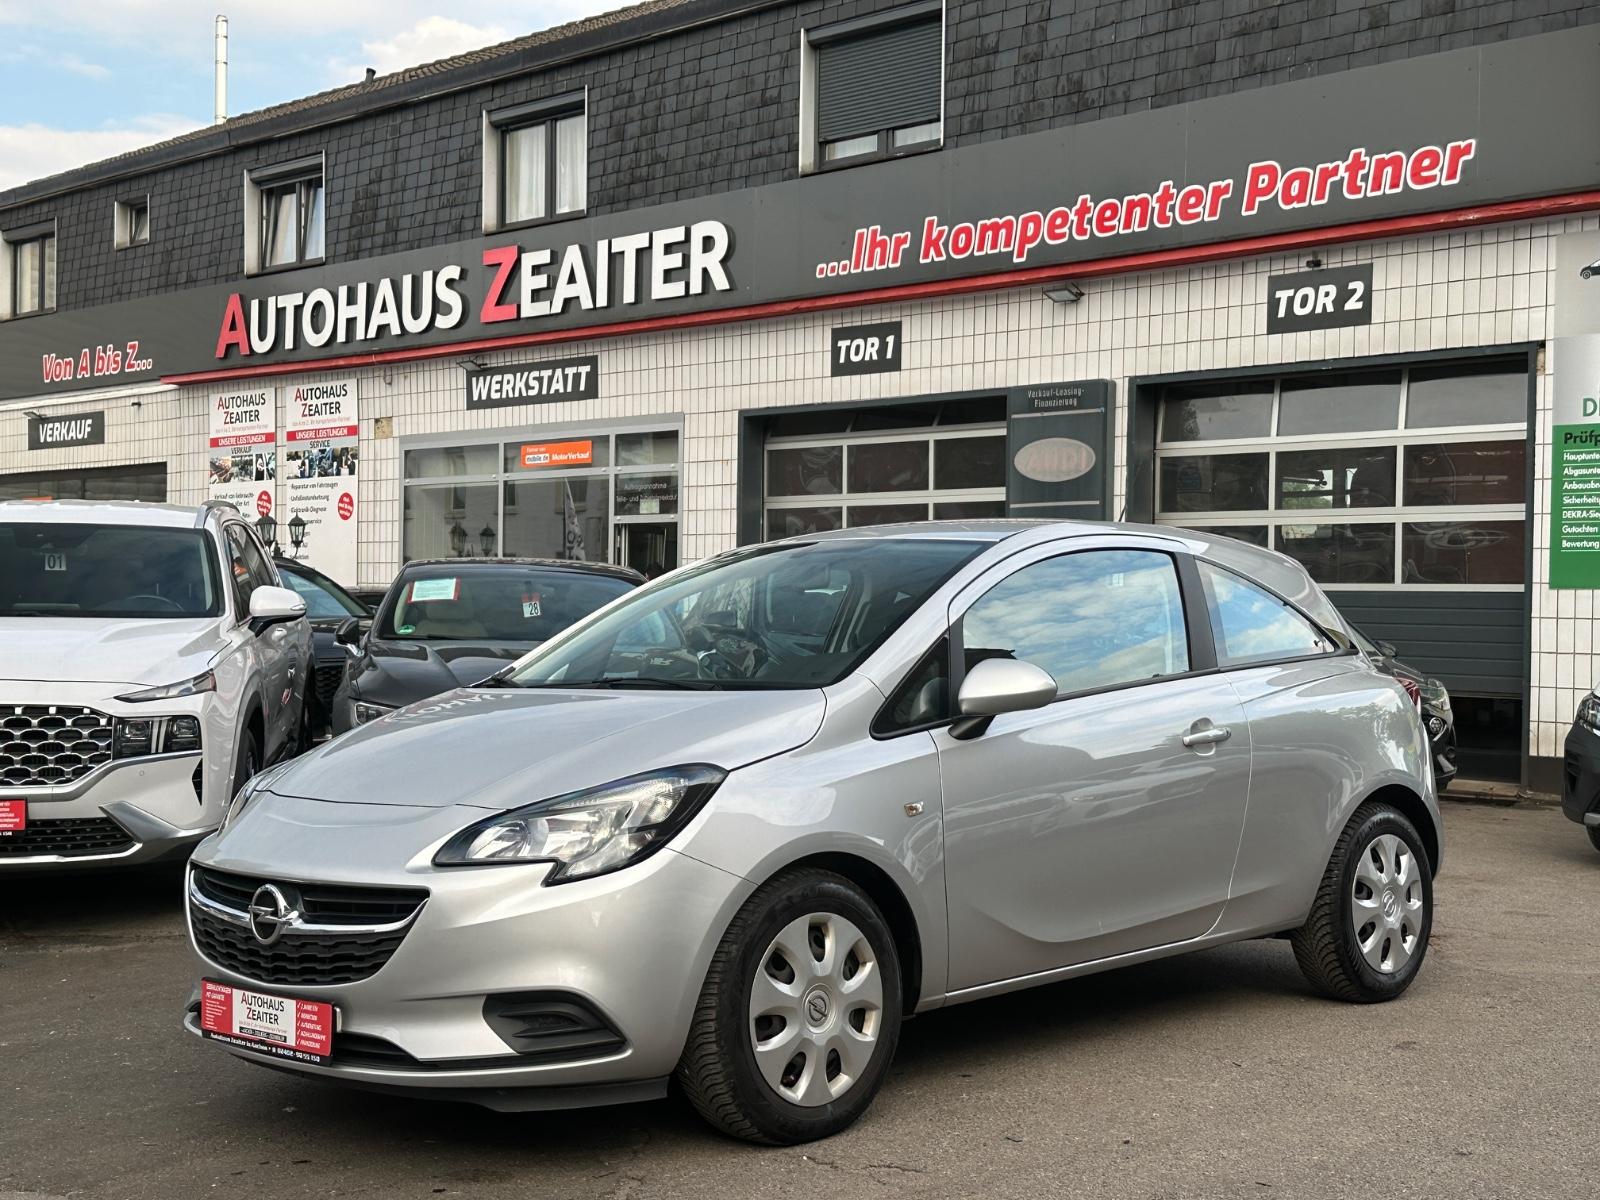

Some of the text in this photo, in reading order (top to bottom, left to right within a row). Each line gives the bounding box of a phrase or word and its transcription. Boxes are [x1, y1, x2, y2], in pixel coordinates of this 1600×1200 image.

[816, 139, 1476, 278] ...Ihr kompetenter Partner
[215, 220, 732, 359] AUTOHAUS ZEAITER
[1273, 280, 1365, 318] TOR 2
[837, 334, 895, 364] TOR 1
[42, 341, 153, 383] Von A bis Z...
[294, 383, 348, 402] AUTOHAUS
[471, 365, 591, 401] WERKSTATT
[217, 392, 266, 411] AUTOHAUS
[301, 401, 341, 418] ZEAITER
[1582, 397, 1600, 417] D
[223, 409, 260, 425] ZEAITER
[39, 418, 92, 443] VERKAUF
[218, 434, 266, 446] UNSERE LEISTUNGEN
[295, 427, 348, 440] UNSERE LEISTUNGEN
[230, 445, 252, 455] VERKAUF
[309, 440, 330, 449] SERVICE
[1562, 524, 1599, 534] Gutachten
[1561, 539, 1600, 550] Bewertung
[47, 554, 64, 570] 01
[528, 602, 539, 616] 28
[241, 992, 285, 1012] AUTOHAUS
[247, 1007, 279, 1026] ZEAITER
